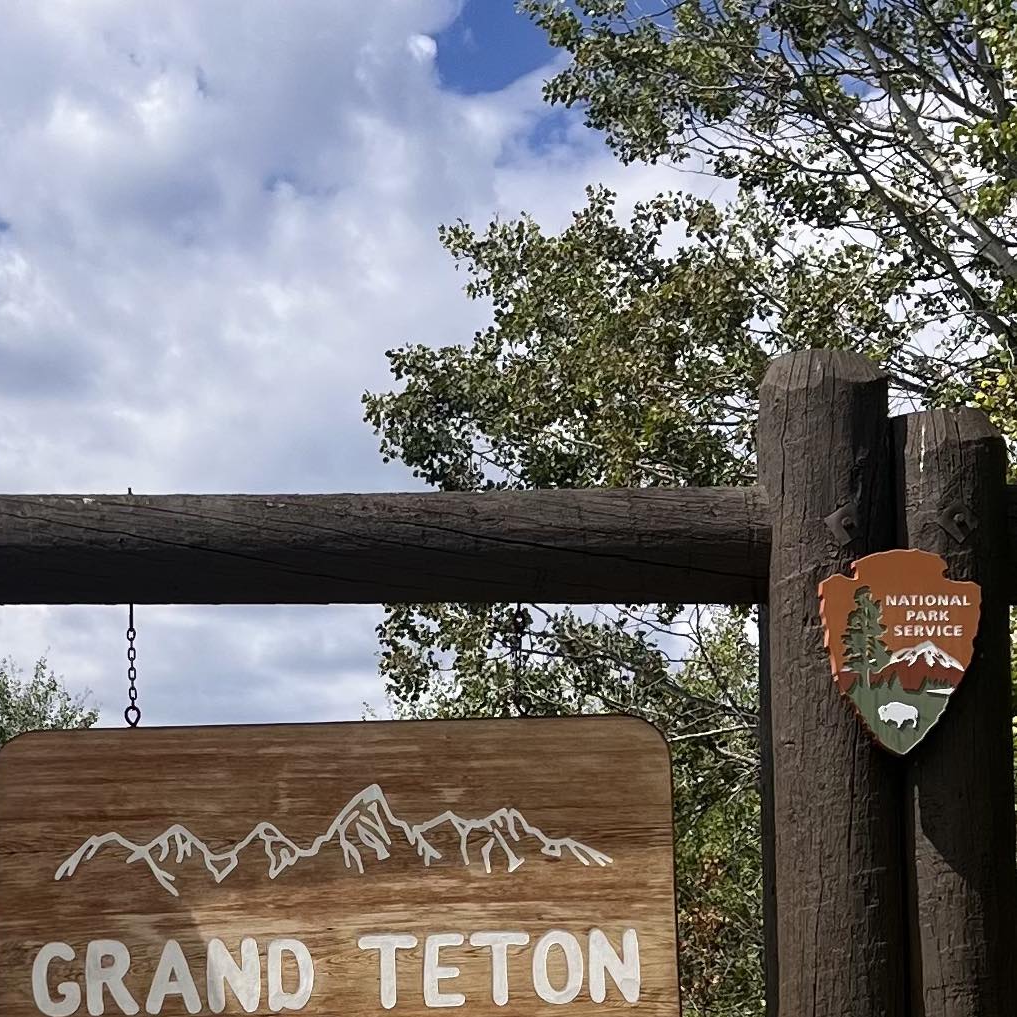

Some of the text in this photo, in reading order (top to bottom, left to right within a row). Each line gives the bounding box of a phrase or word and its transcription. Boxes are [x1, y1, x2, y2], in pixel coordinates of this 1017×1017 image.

[885, 594, 971, 607] NATIONAL
[905, 610, 950, 622] PARK
[893, 624, 964, 637] SERVICE
[31, 927, 641, 1017] GRAND TETON
